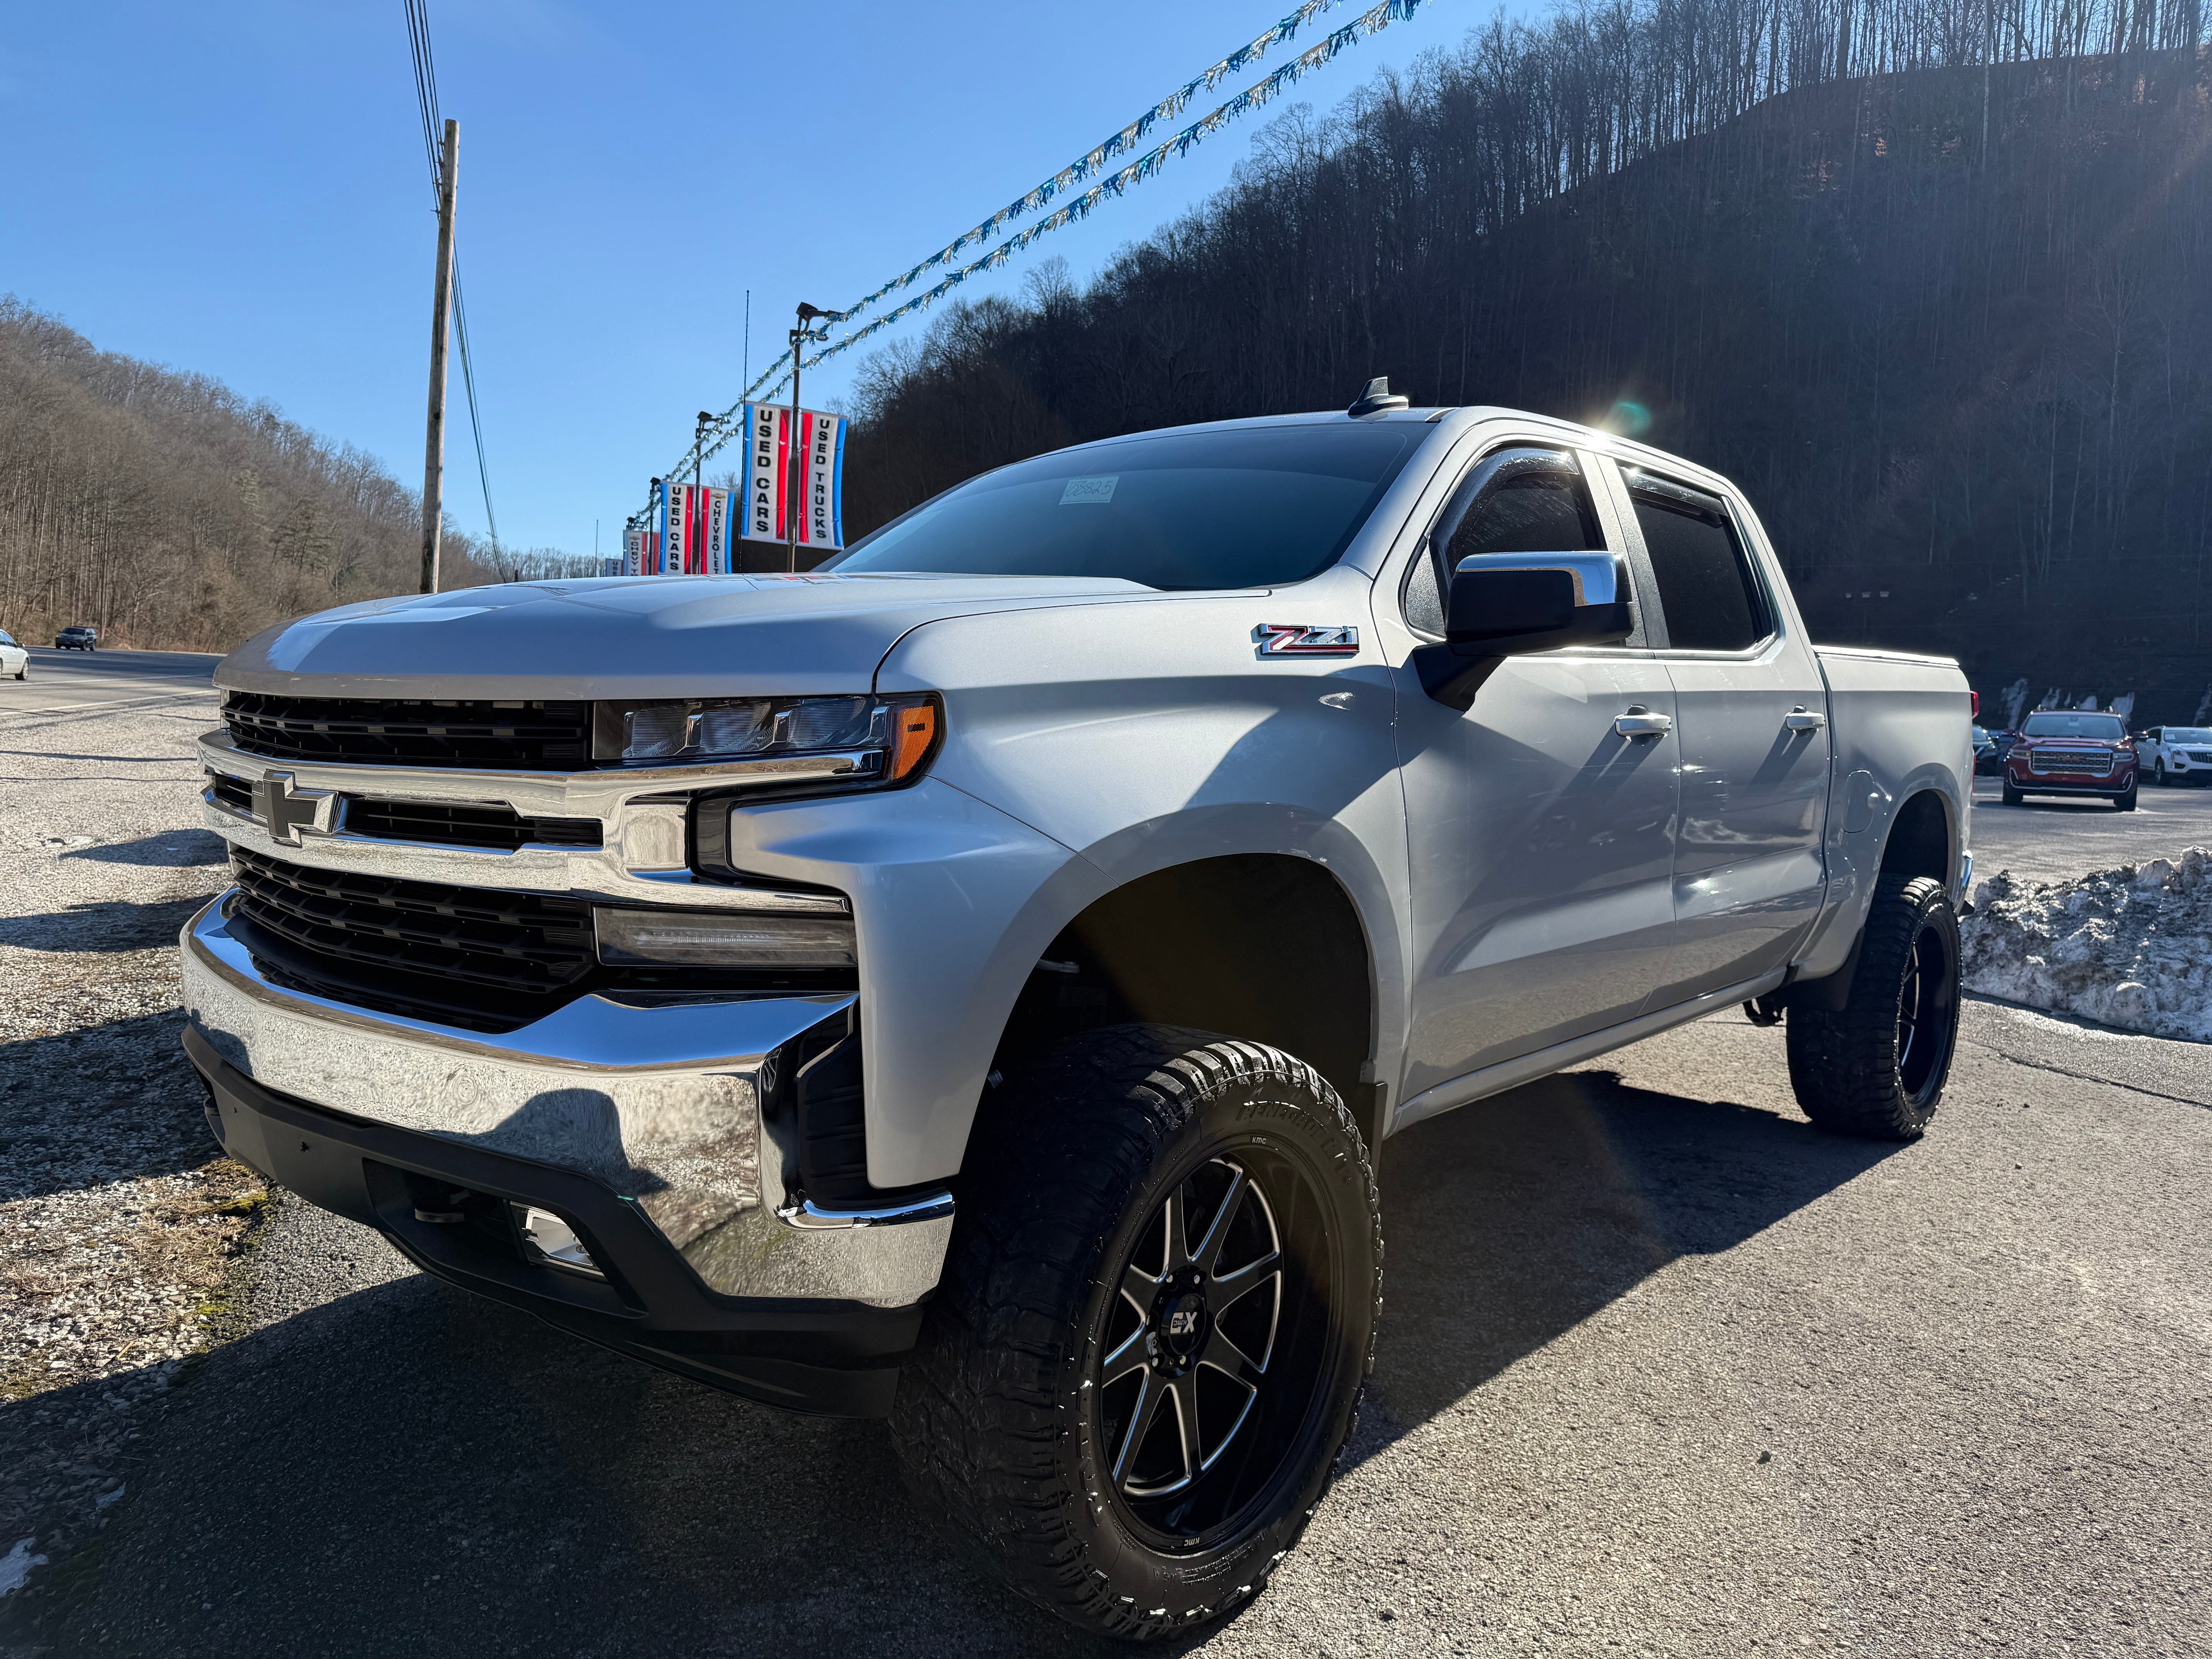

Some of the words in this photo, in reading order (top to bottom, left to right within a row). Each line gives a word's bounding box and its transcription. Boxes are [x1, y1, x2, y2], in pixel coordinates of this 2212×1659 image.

[757, 410, 773, 467] USED
[816, 419, 830, 465] USED
[671, 486, 682, 526] USED
[756, 477, 770, 532] CARS
[815, 472, 826, 538] TRUCKS
[670, 533, 680, 570] CARS
[712, 501, 721, 574] CHEVROLET
[1258, 623, 1360, 654] Z71
[1252, 1136, 1267, 1145] KMC
[1184, 1536, 1200, 1547] KMC
